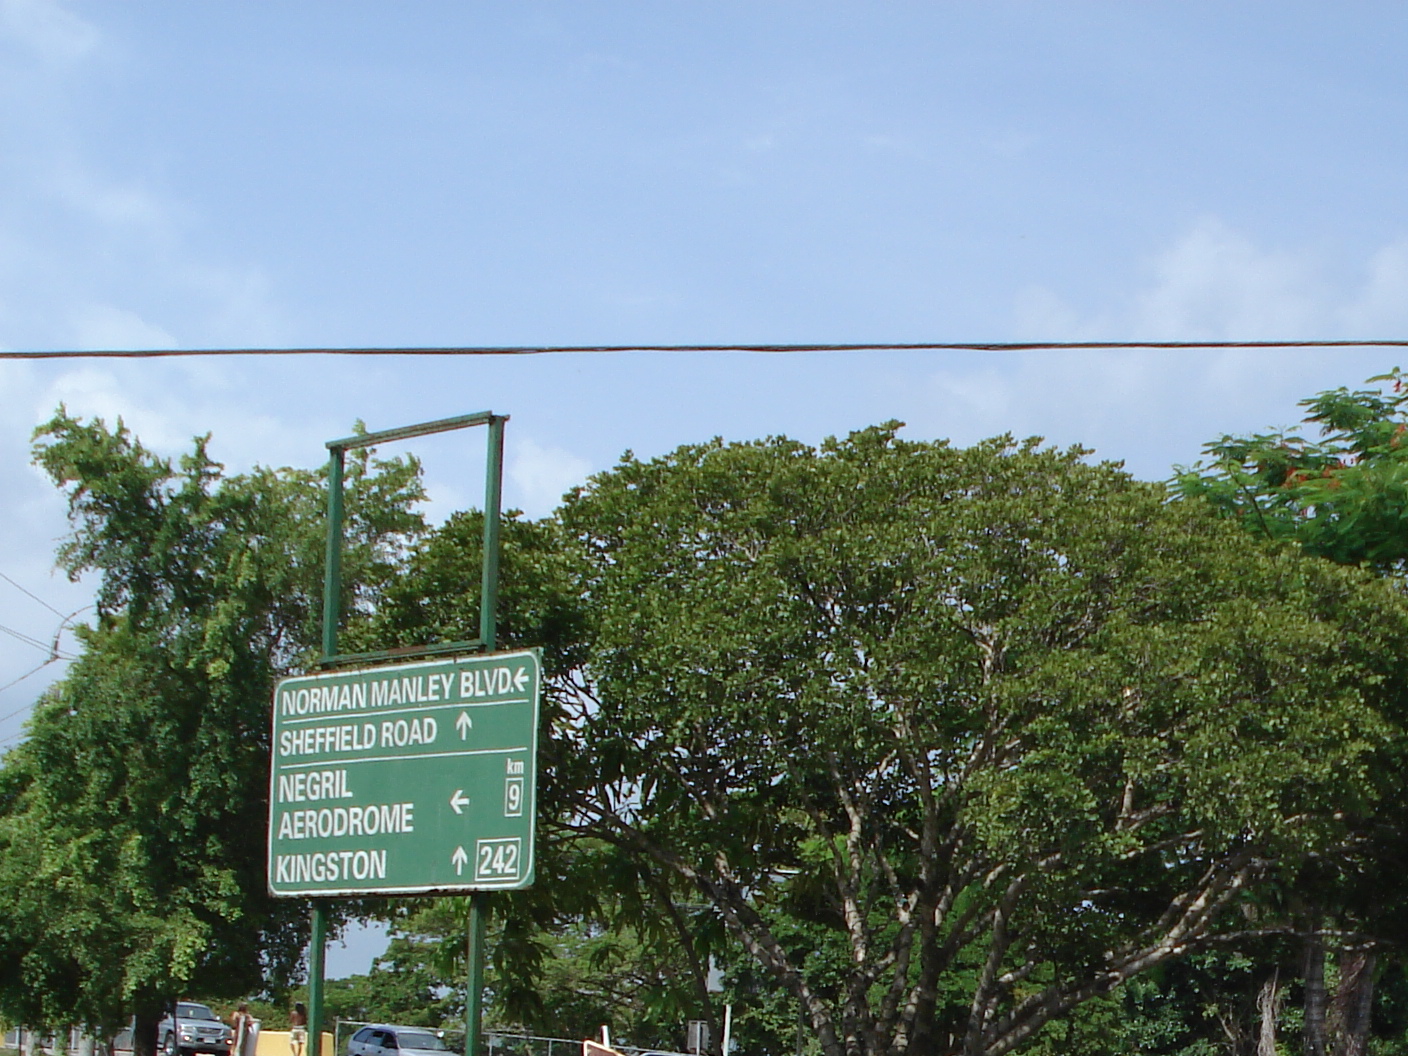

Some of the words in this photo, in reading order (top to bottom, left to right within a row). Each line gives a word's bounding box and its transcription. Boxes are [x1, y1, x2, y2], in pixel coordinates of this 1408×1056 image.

[281, 683, 366, 716] NORMAN
[371, 673, 455, 707] MANLEY
[280, 725, 376, 756] SHEFFIELD
[381, 717, 437, 748] ROAD
[506, 758, 524, 775] km
[279, 770, 353, 803] NEGRIL
[508, 784, 520, 810] 9
[278, 803, 414, 840] AERODROME
[276, 850, 386, 883] KINGSTON
[478, 845, 518, 875] 242
